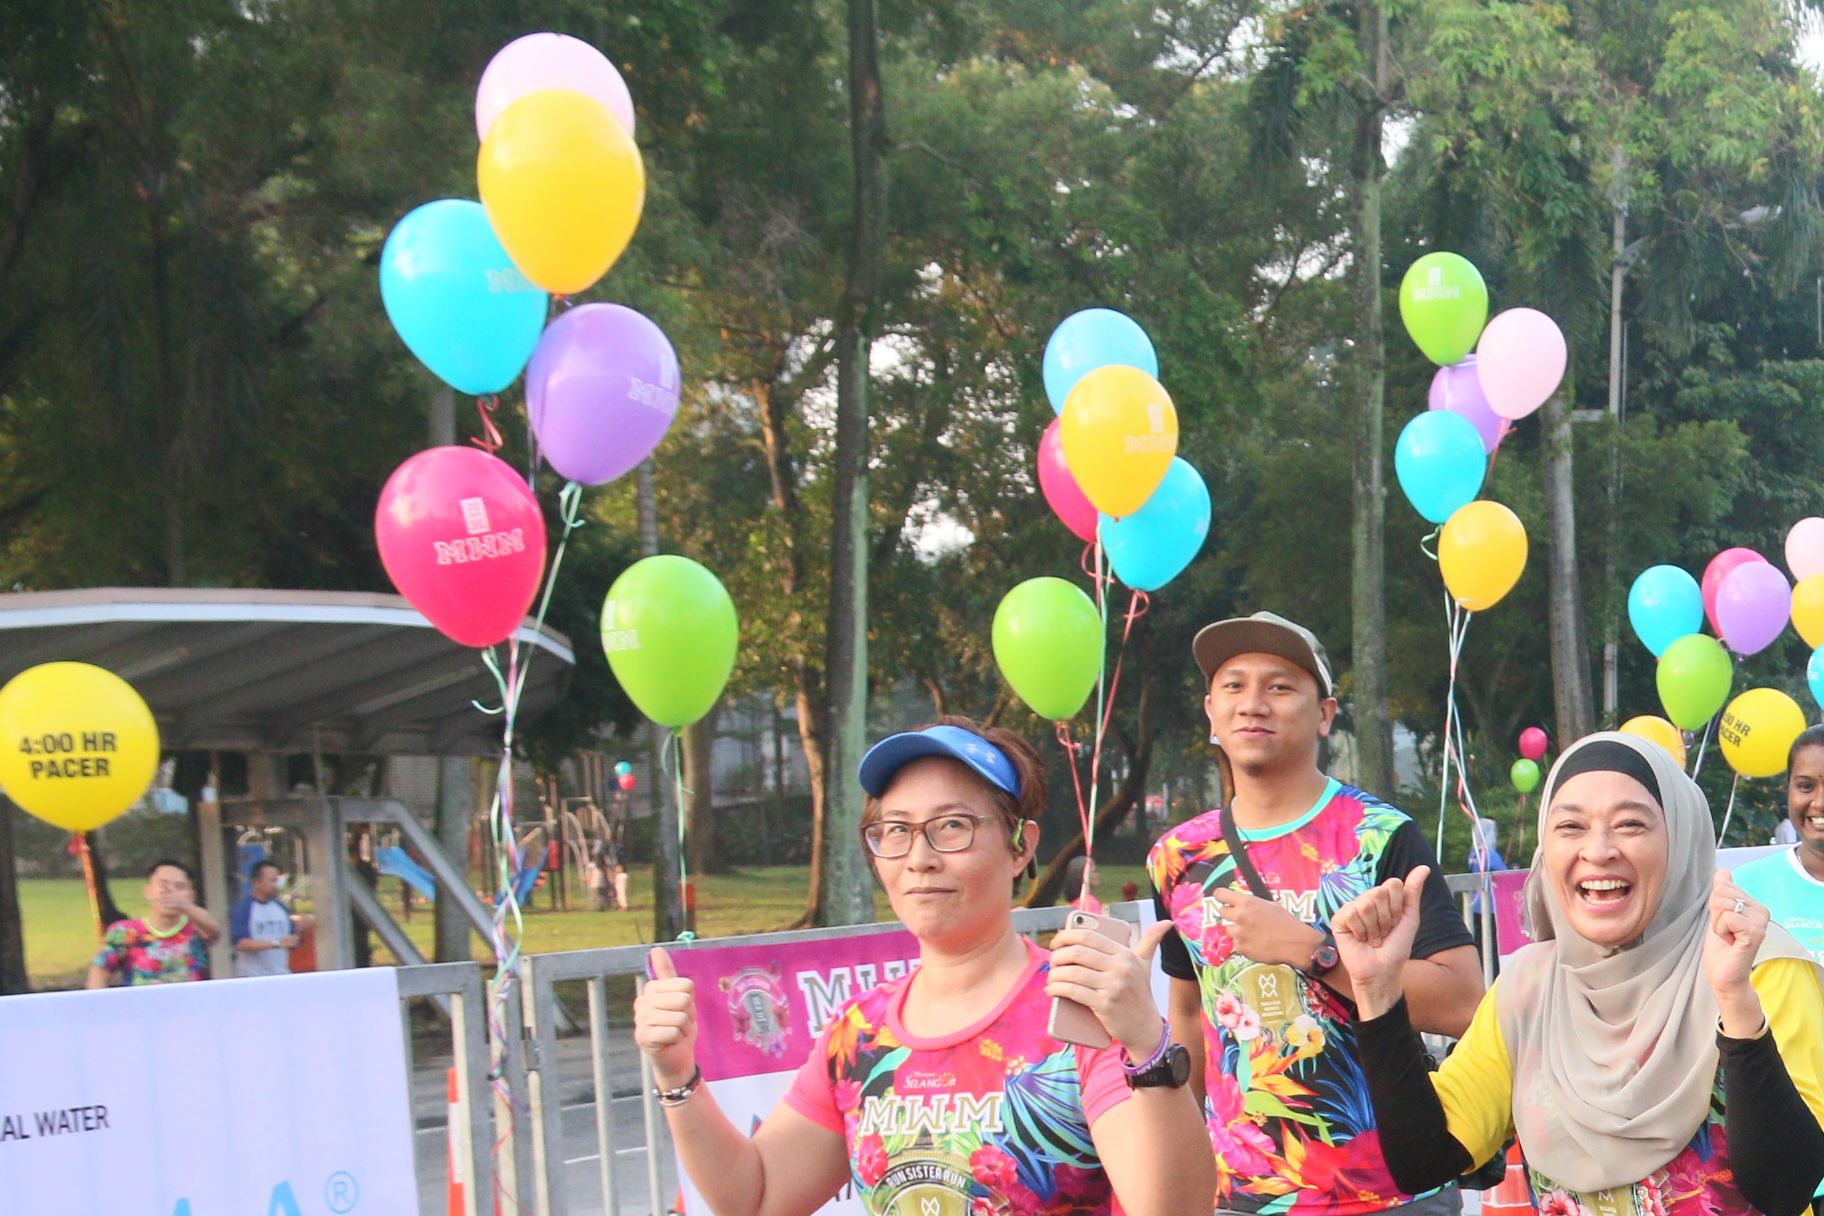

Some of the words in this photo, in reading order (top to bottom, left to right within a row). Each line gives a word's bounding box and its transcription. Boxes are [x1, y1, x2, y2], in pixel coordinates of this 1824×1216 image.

[434, 529, 524, 566] MWM
[19, 734, 74, 755] 4:00
[81, 732, 117, 753] HR
[31, 758, 110, 779] PACER
[34, 1105, 110, 1138] WATER
[860, 1091, 1006, 1137] MWM
[905, 1165, 942, 1180] SISTER
[943, 1169, 967, 1189] RUN
